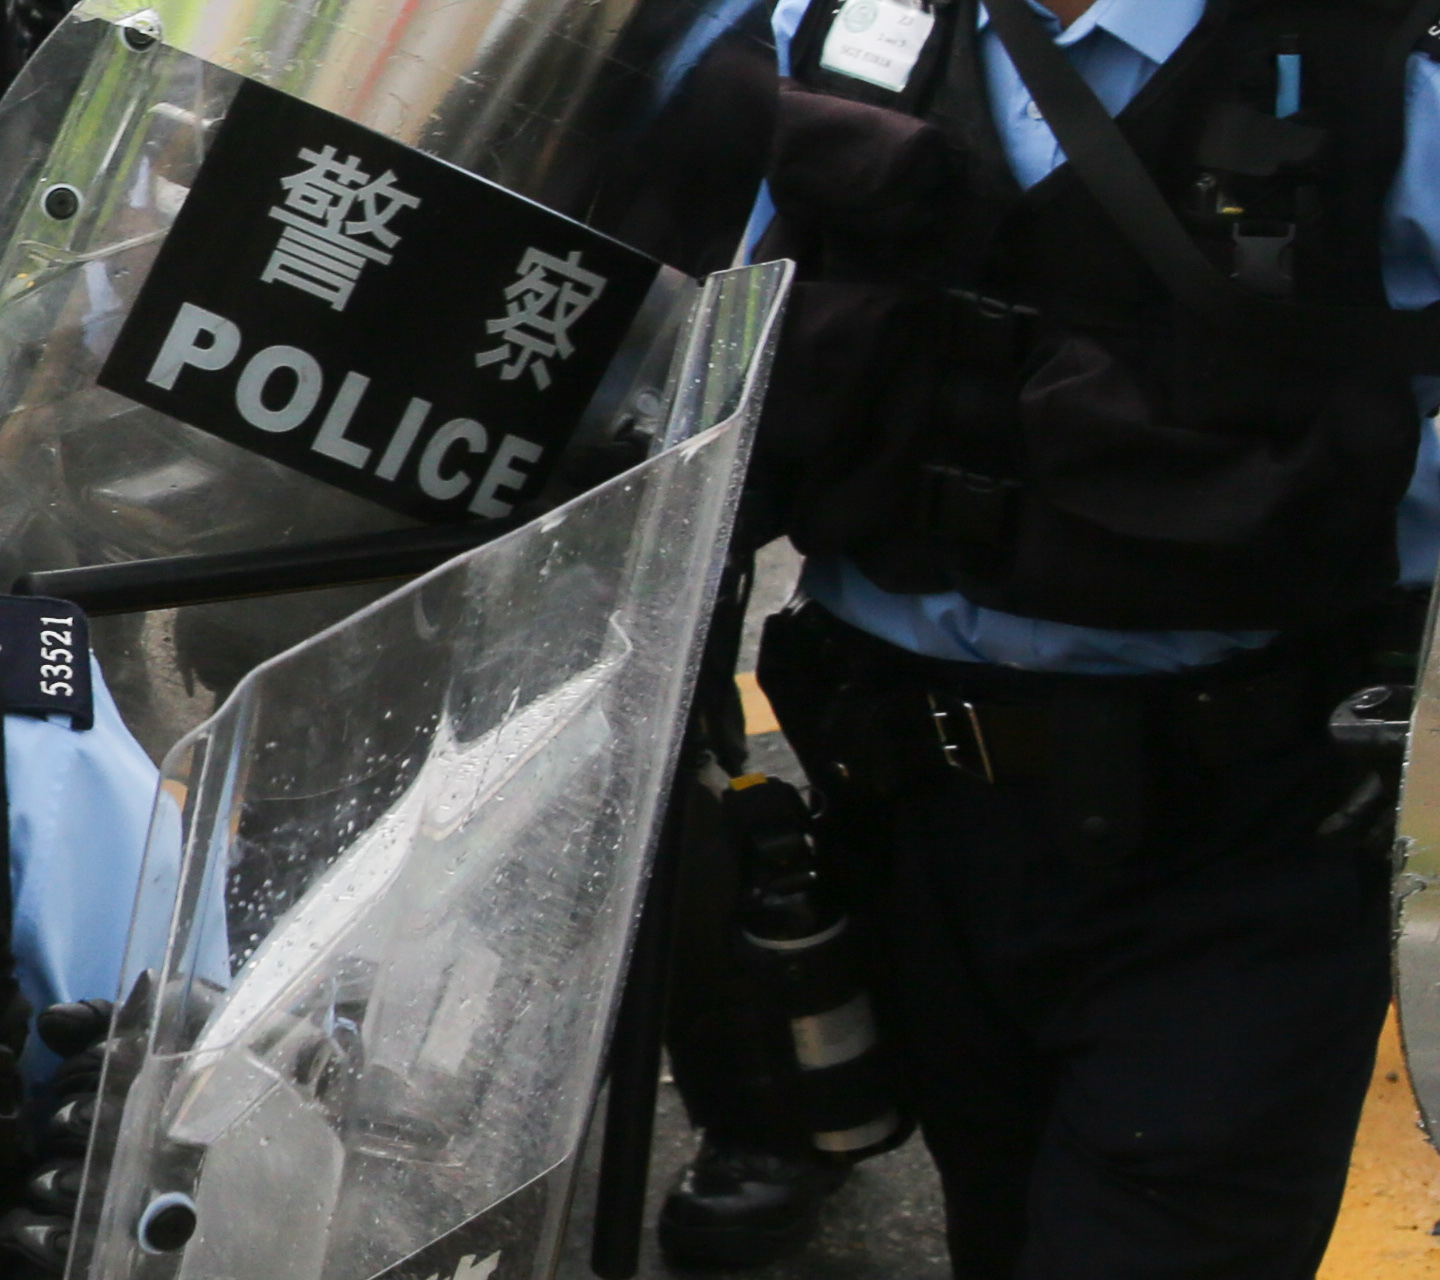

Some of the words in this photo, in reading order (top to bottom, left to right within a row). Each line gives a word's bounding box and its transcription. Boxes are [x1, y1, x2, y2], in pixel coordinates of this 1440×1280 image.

[259, 142, 608, 393] 警察
[145, 300, 544, 520] POLICE
[40, 616, 73, 697] 53521
